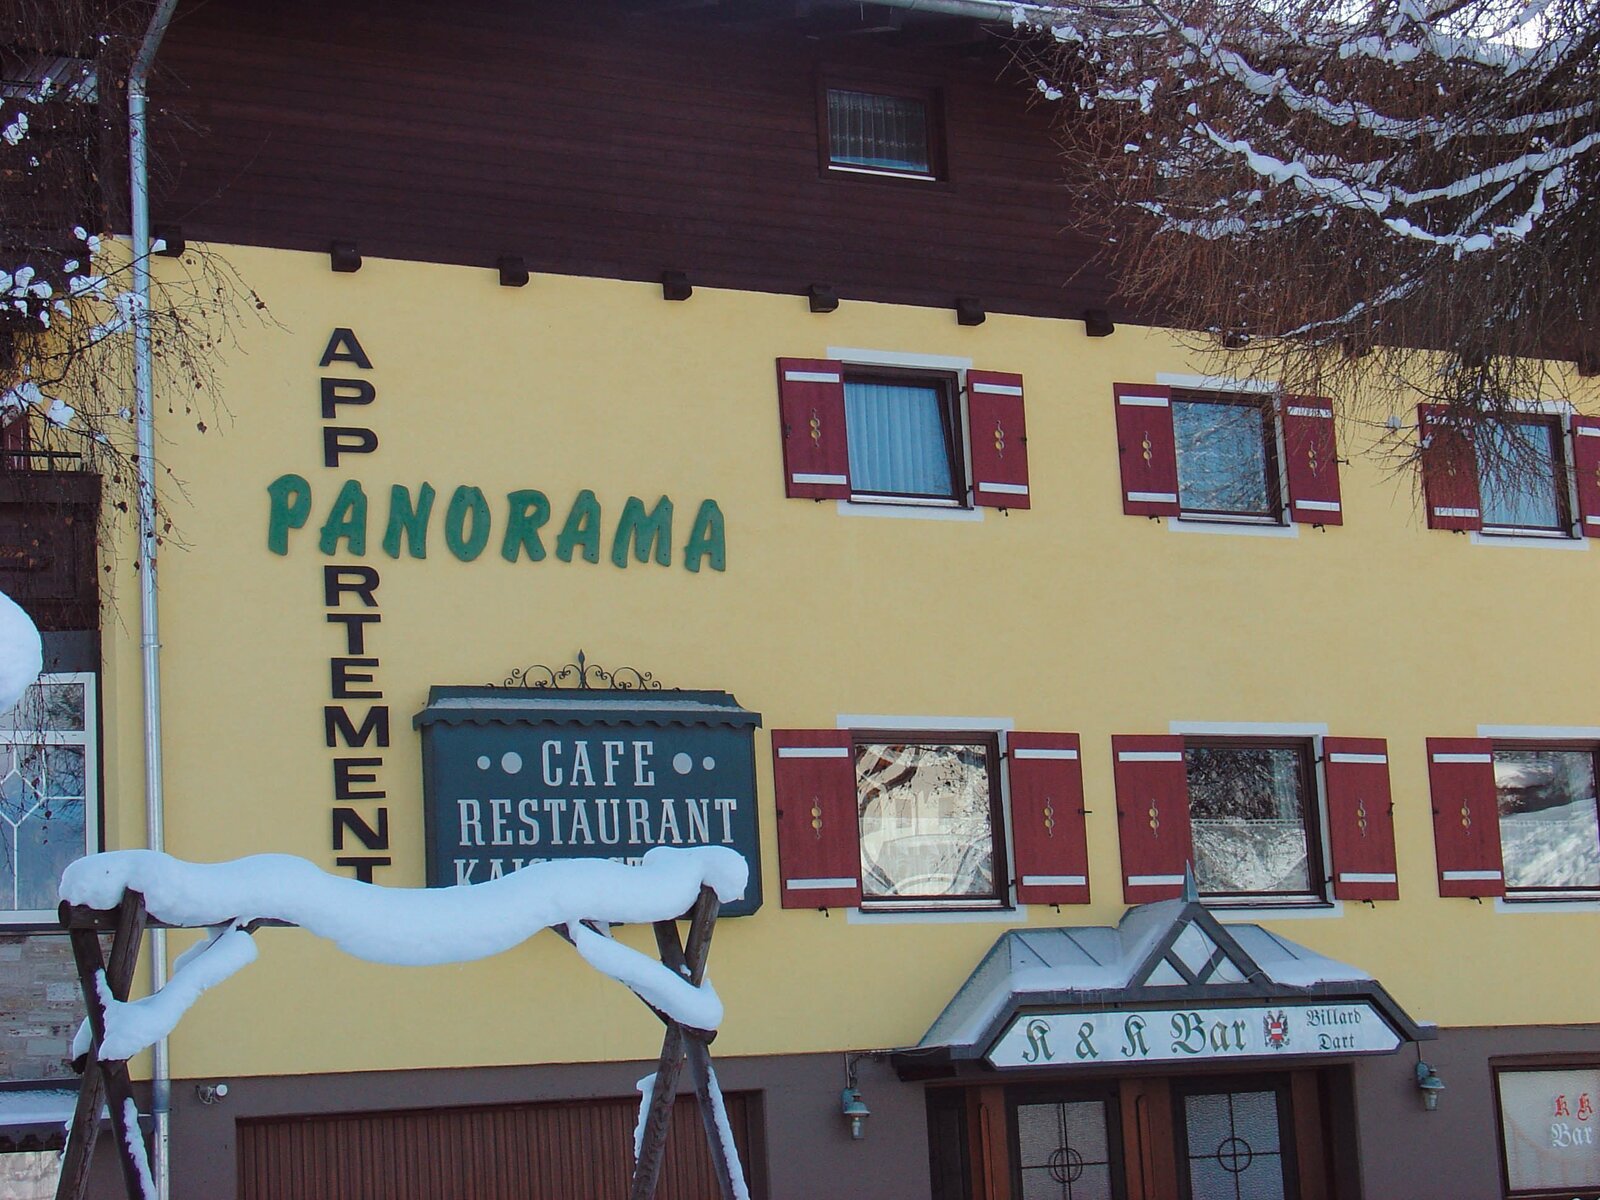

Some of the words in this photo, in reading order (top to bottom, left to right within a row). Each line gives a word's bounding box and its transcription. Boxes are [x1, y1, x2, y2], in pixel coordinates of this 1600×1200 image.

[266, 473, 726, 573] PANORAMA
[541, 740, 656, 787] CAFE
[457, 798, 738, 846] RESTAURANT
[1075, 1022, 1099, 1059] &
[1170, 1012, 1247, 1054] Bar
[1306, 1007, 1362, 1027] Billard
[1318, 1032, 1355, 1051] Dart
[1551, 1122, 1592, 1148] Bar
